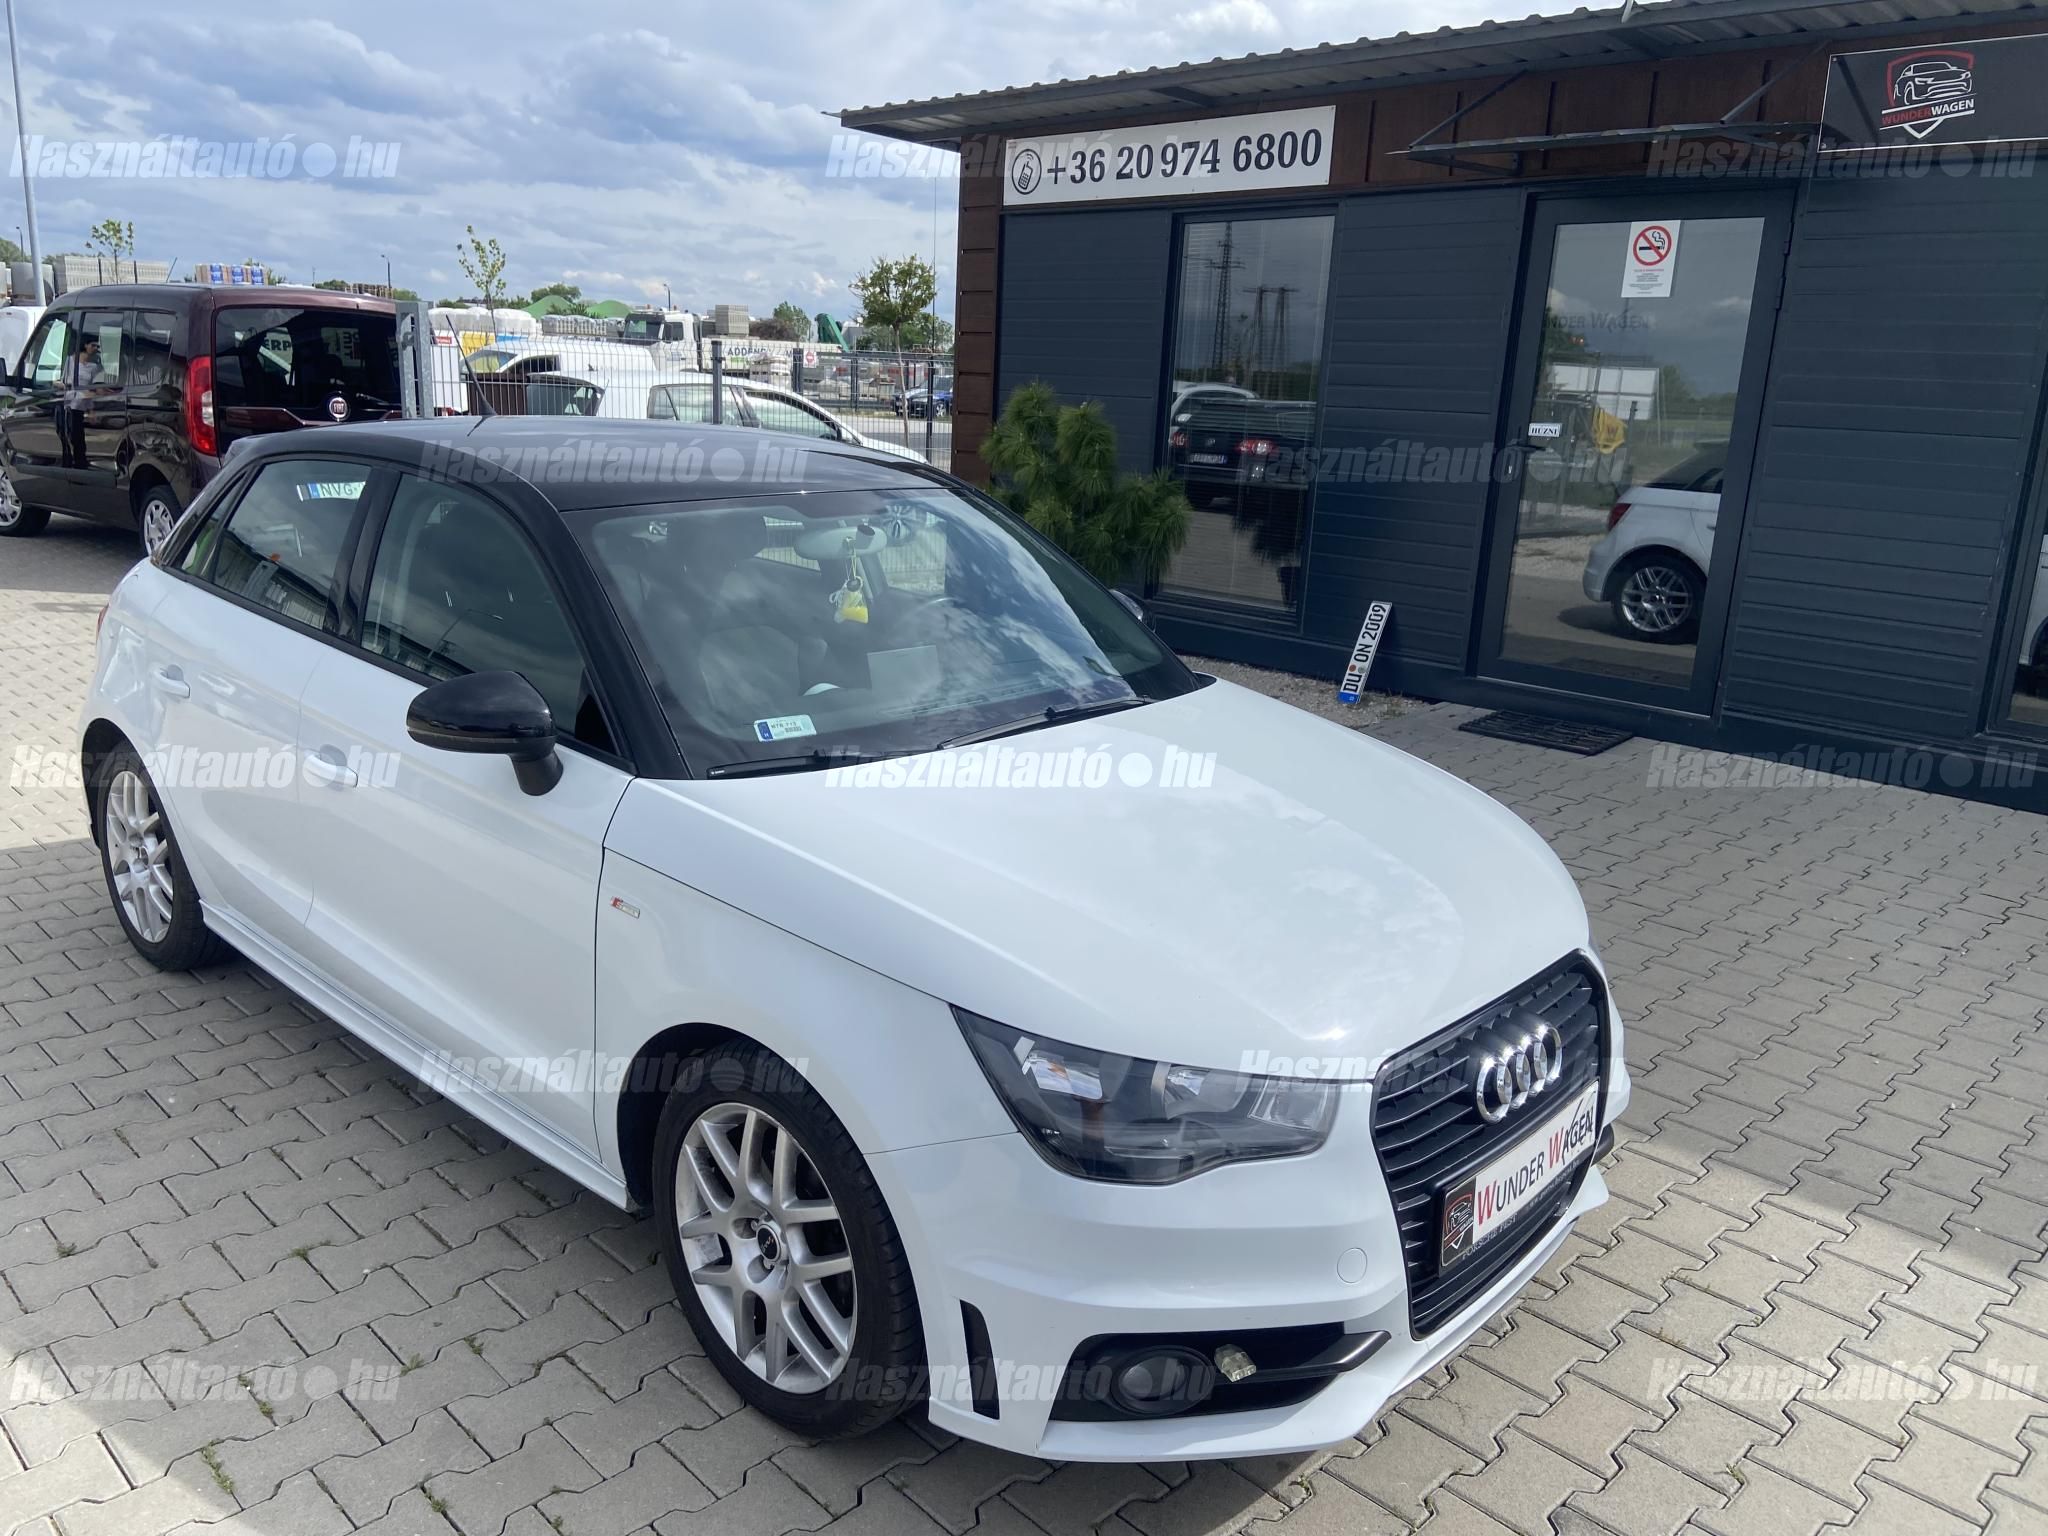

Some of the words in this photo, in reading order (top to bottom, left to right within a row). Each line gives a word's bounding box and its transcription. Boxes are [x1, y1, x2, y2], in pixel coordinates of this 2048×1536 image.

[1047, 149, 1106, 184] +36
[1116, 144, 1154, 180] 20
[1160, 138, 1221, 178] 974
[1232, 128, 1323, 173] 6800
[1361, 604, 1387, 641] 2009
[1353, 643, 1374, 663] ON
[1343, 673, 1363, 693] DU
[1477, 1151, 1545, 1226] WUNDER
[1549, 1103, 1594, 1169] WAGEN
